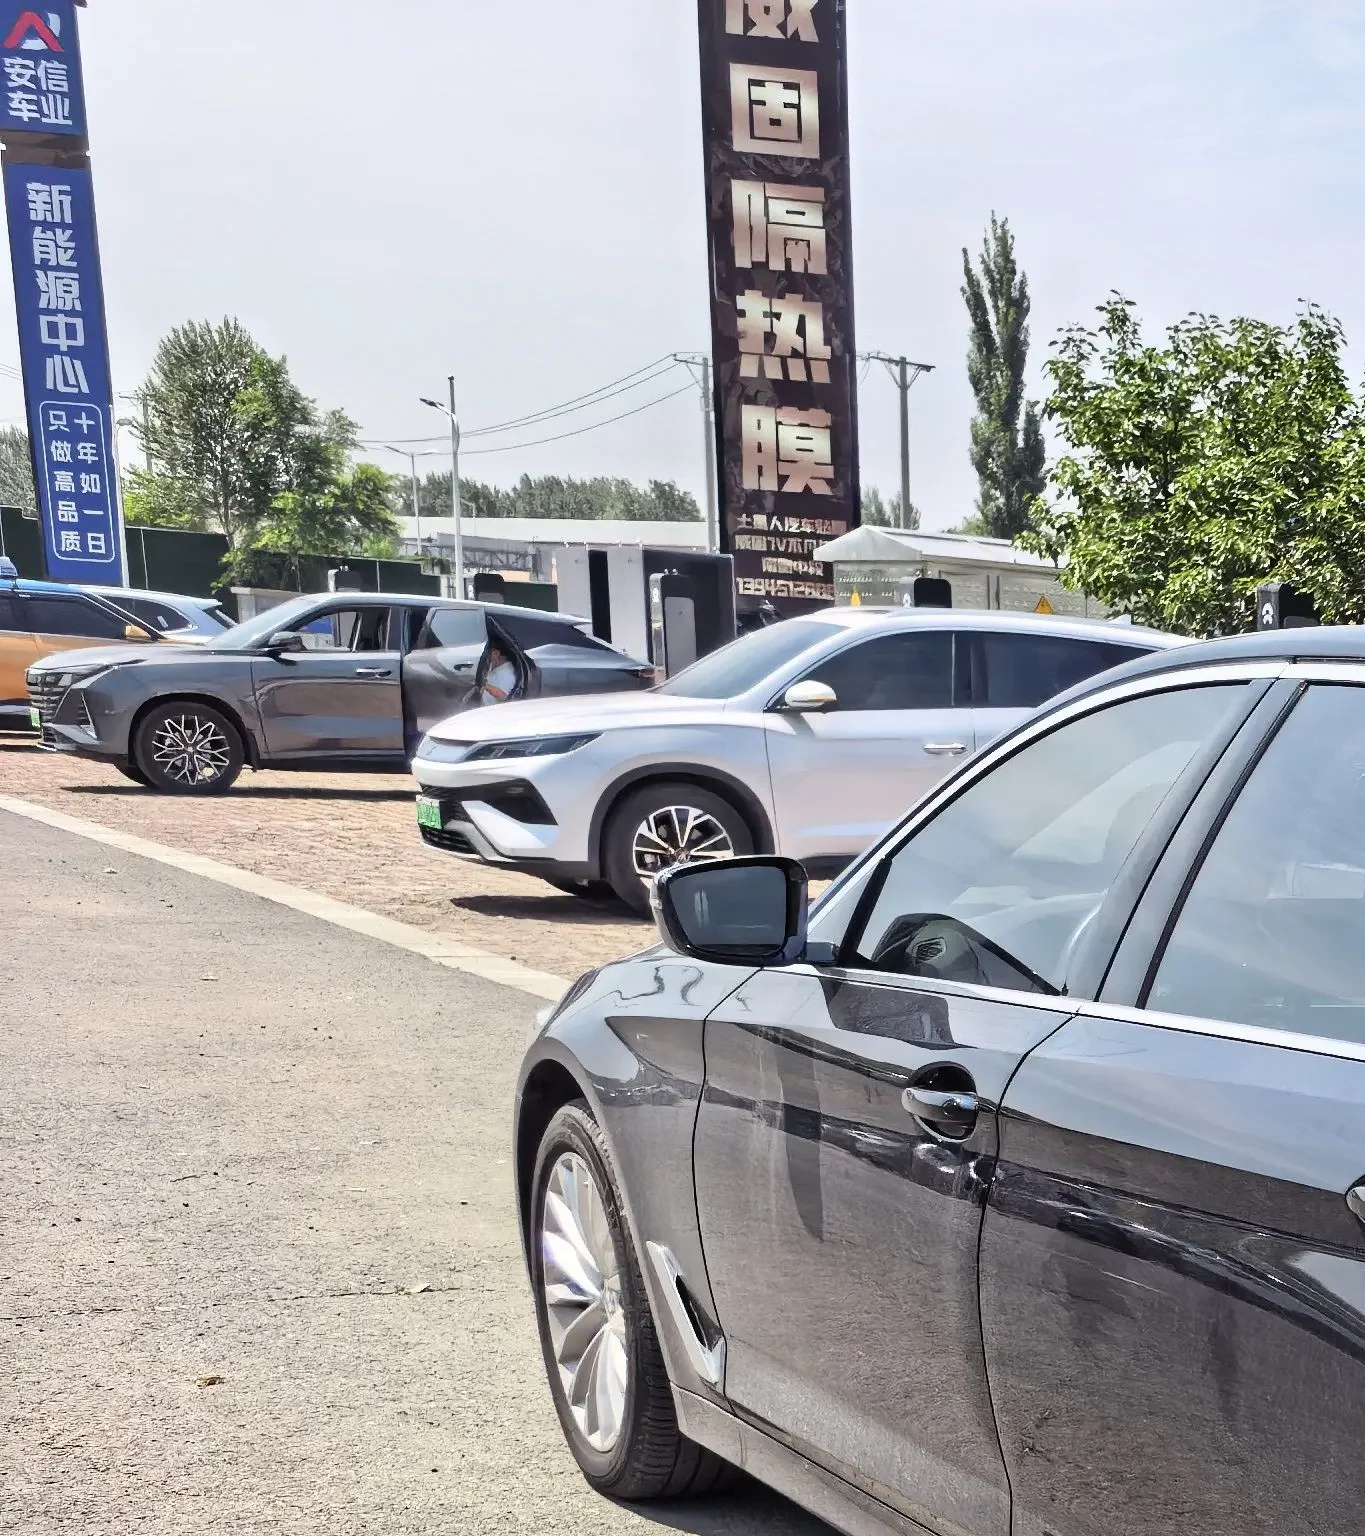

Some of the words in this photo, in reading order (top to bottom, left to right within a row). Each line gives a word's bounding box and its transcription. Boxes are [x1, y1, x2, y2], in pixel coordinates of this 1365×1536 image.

[2, 57, 69, 92] 安信
[4, 91, 73, 125] 车业
[26, 182, 90, 394] 新能源中心
[49, 410, 83, 553] 只做高品质
[73, 411, 106, 555] 十年如一日
